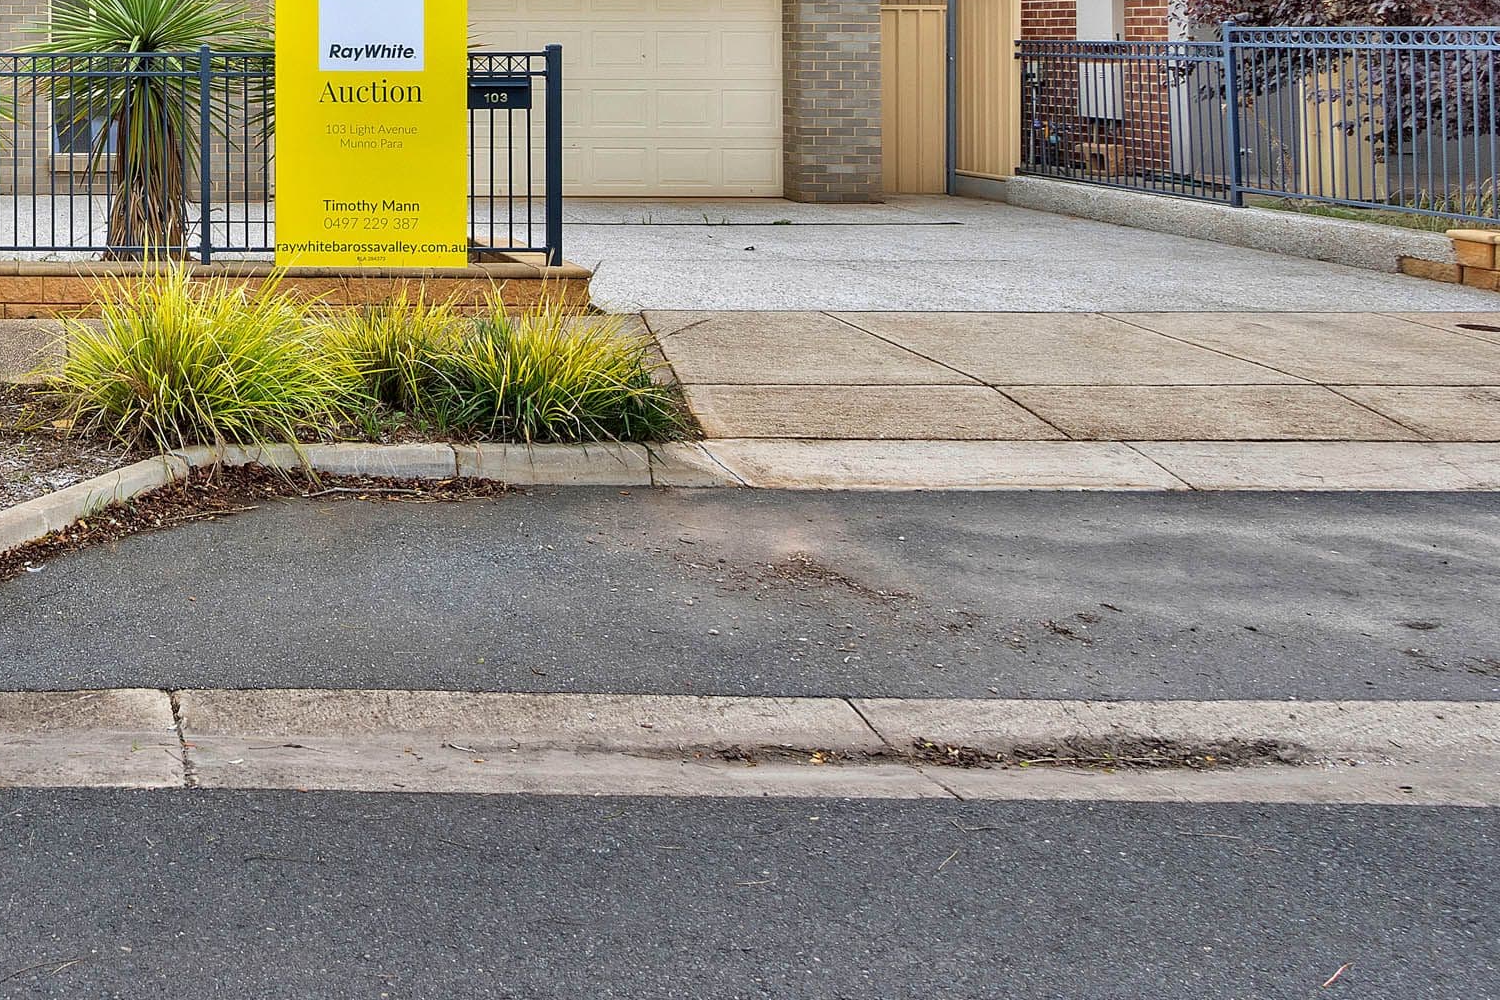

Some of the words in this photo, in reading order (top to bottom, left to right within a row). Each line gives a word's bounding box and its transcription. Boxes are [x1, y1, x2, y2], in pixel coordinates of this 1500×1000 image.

[319, 79, 423, 103] Auction
[484, 92, 508, 103] 103
[326, 124, 347, 135] 103
[349, 123, 375, 136] Light
[378, 124, 418, 135] Avenue
[340, 138, 377, 149] Munno
[380, 138, 403, 149] Para
[323, 199, 378, 214] Timothy
[382, 200, 420, 212] Mann
[323, 217, 358, 230] 0497
[363, 217, 388, 230] 229
[393, 217, 419, 230] 387
[276, 241, 467, 254] raywhitebarossavalley.com.au
